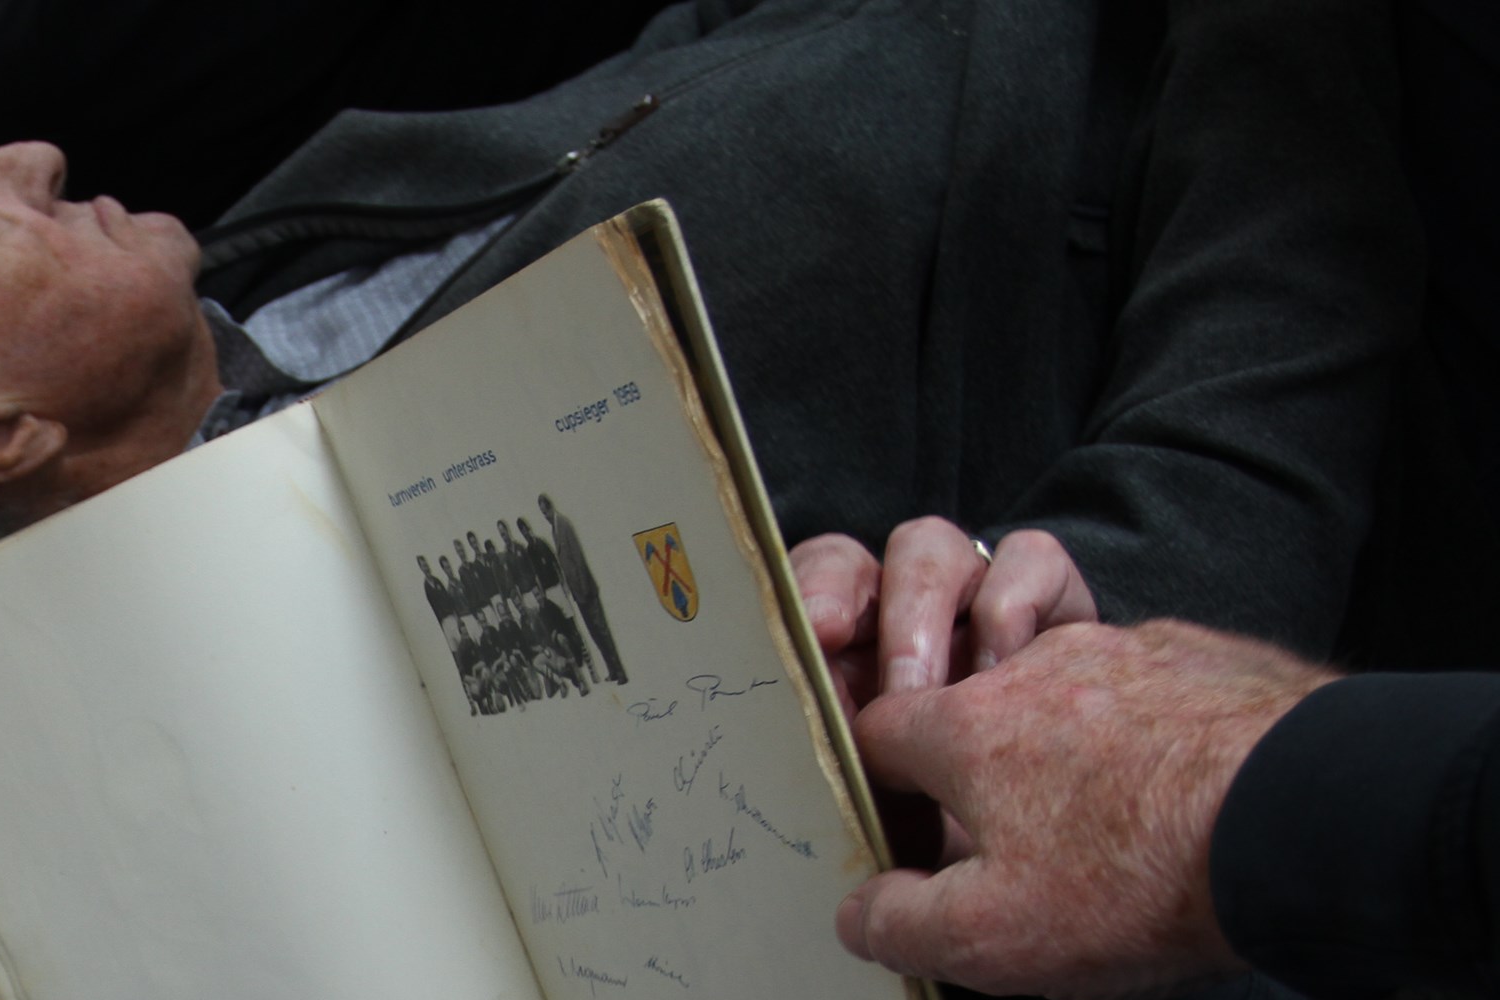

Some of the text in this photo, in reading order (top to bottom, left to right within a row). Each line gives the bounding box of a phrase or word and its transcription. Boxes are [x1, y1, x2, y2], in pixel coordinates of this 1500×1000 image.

[555, 399, 610, 432] cupsieger
[388, 449, 497, 507] turnverein unterstrass
